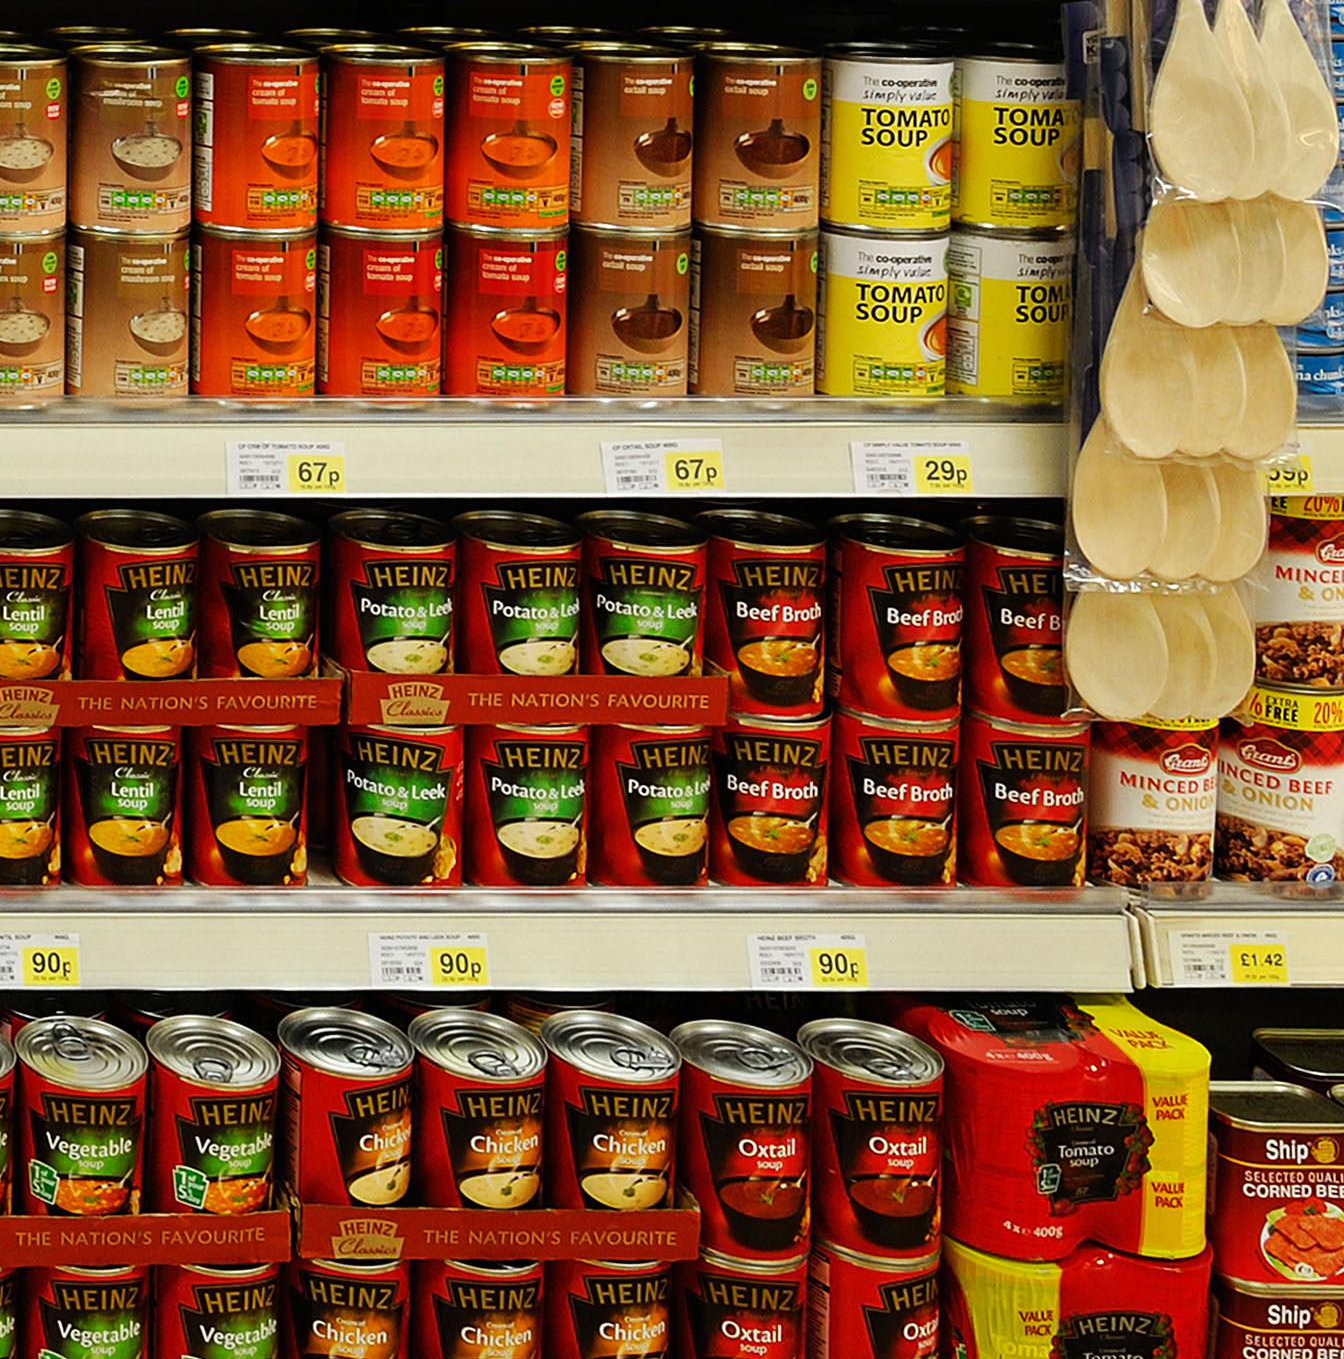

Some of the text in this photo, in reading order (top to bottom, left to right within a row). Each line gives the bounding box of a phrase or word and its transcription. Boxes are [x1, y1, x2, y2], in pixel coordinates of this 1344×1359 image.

[861, 107, 950, 127] TOMATO
[860, 127, 928, 147] SOUP
[924, 460, 967, 483] 29p
[1265, 704, 1299, 722] FREE
[346, 770, 447, 802] Potato & Leek
[863, 778, 953, 802] Beef Broth
[1240, 953, 1283, 968] £1.42
[1152, 1094, 1188, 1109] VALUE
[1155, 1106, 1185, 1121] PACK
[739, 1138, 796, 1160] Oxtail
[1266, 1138, 1309, 1164] Ship
